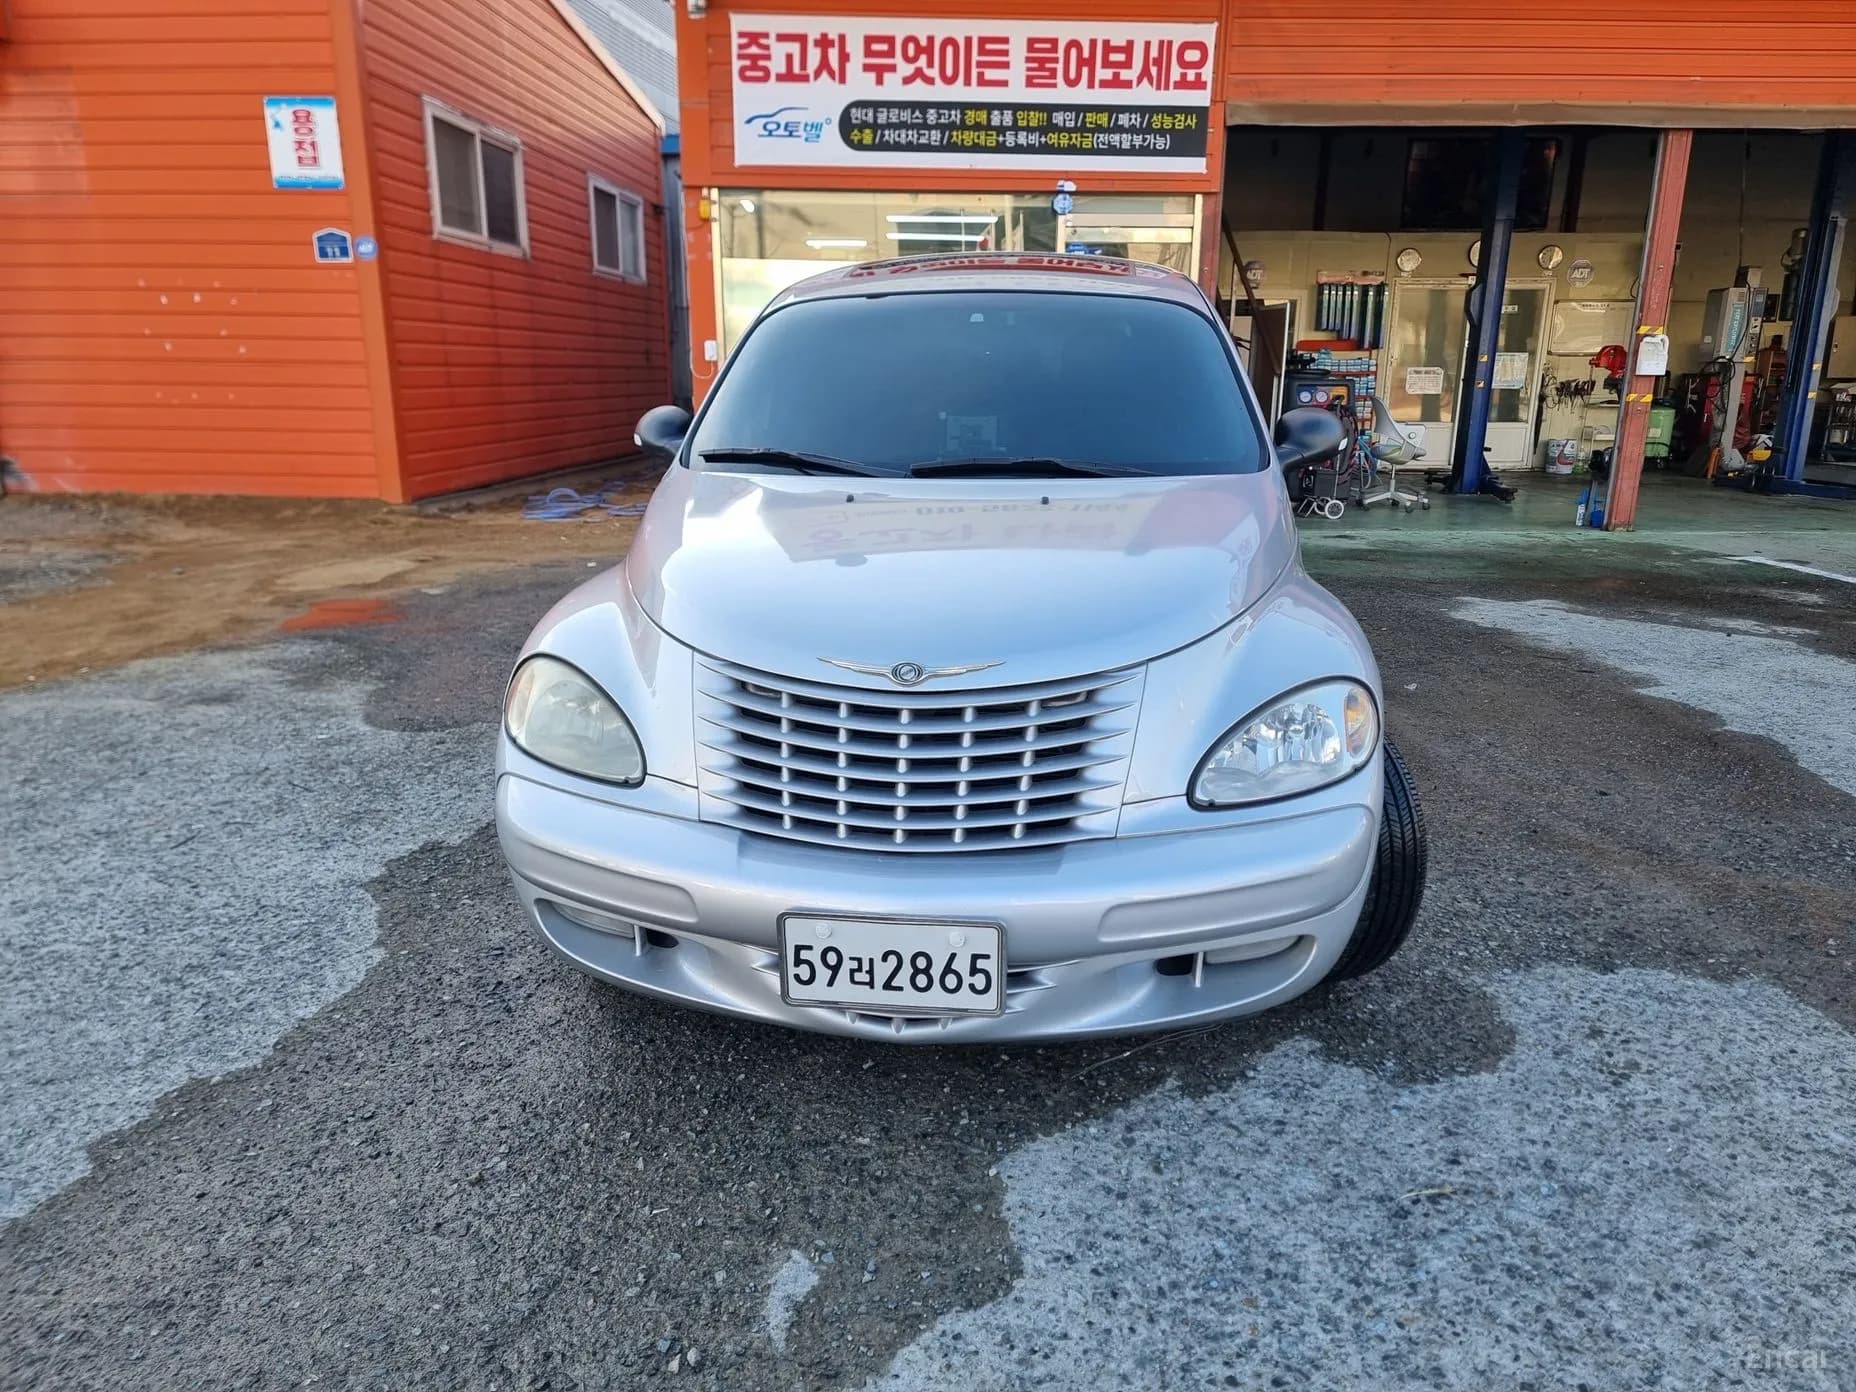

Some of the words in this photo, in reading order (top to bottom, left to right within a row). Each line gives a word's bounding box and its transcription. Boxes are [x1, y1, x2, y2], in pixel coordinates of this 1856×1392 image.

[737, 31, 850, 85] 중고차
[862, 34, 1010, 88] 무엇이든
[1025, 37, 1209, 91] 물어보세요
[850, 107, 874, 124] 현대
[876, 107, 924, 125] 글로비스
[926, 108, 961, 126] 중고차
[964, 109, 988, 126] 경매
[990, 109, 1013, 126] 출품
[1016, 110, 1047, 127] 입찰!!
[1052, 111, 1076, 128] 매입
[1085, 111, 1109, 128] 판매
[1151, 112, 1198, 129] 성능검사
[292, 109, 320, 167] 용접
[758, 121, 823, 143] 오토벨
[849, 128, 873, 145] 수출
[882, 128, 941, 146] 차대차교환
[1569, 268, 1591, 279] ADT
[793, 943, 992, 996] 59러2865
